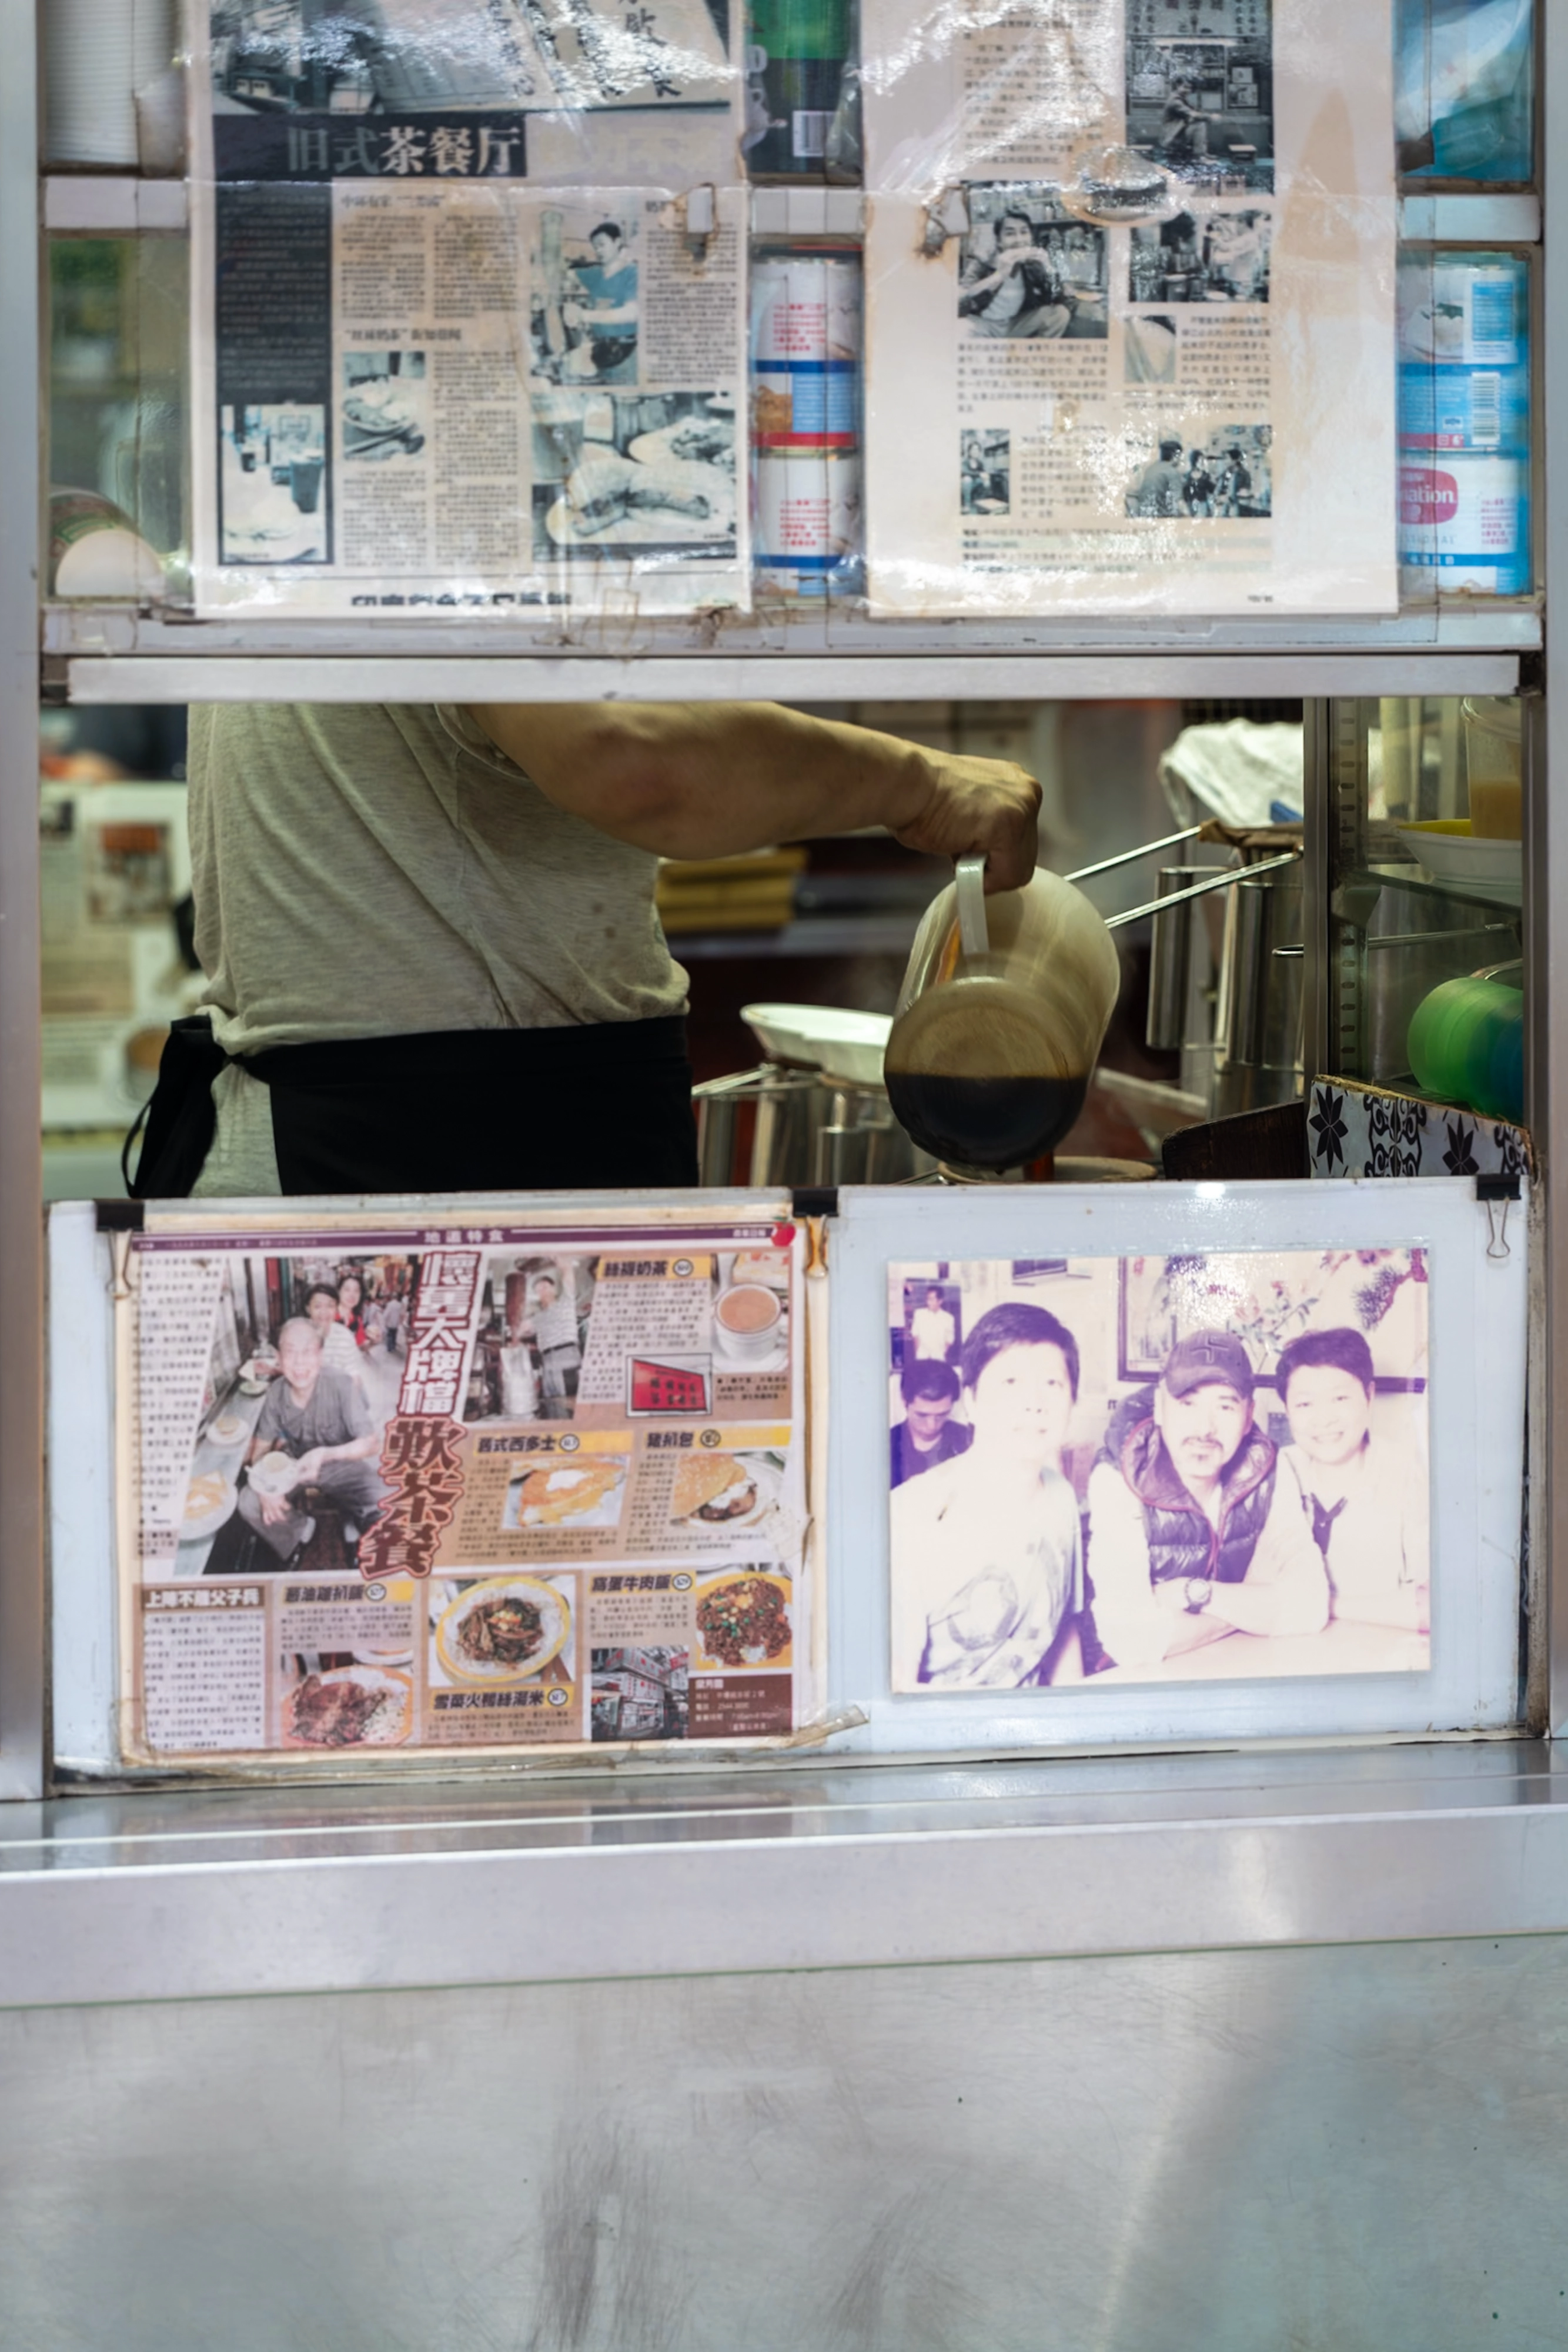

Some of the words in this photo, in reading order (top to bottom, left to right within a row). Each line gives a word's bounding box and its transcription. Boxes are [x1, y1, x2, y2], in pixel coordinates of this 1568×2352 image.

[288, 126, 521, 175] 旧式茶餐厅
[398, 1252, 480, 1415] 懷舊大牌檔
[479, 1435, 556, 1453] 舊式西多士
